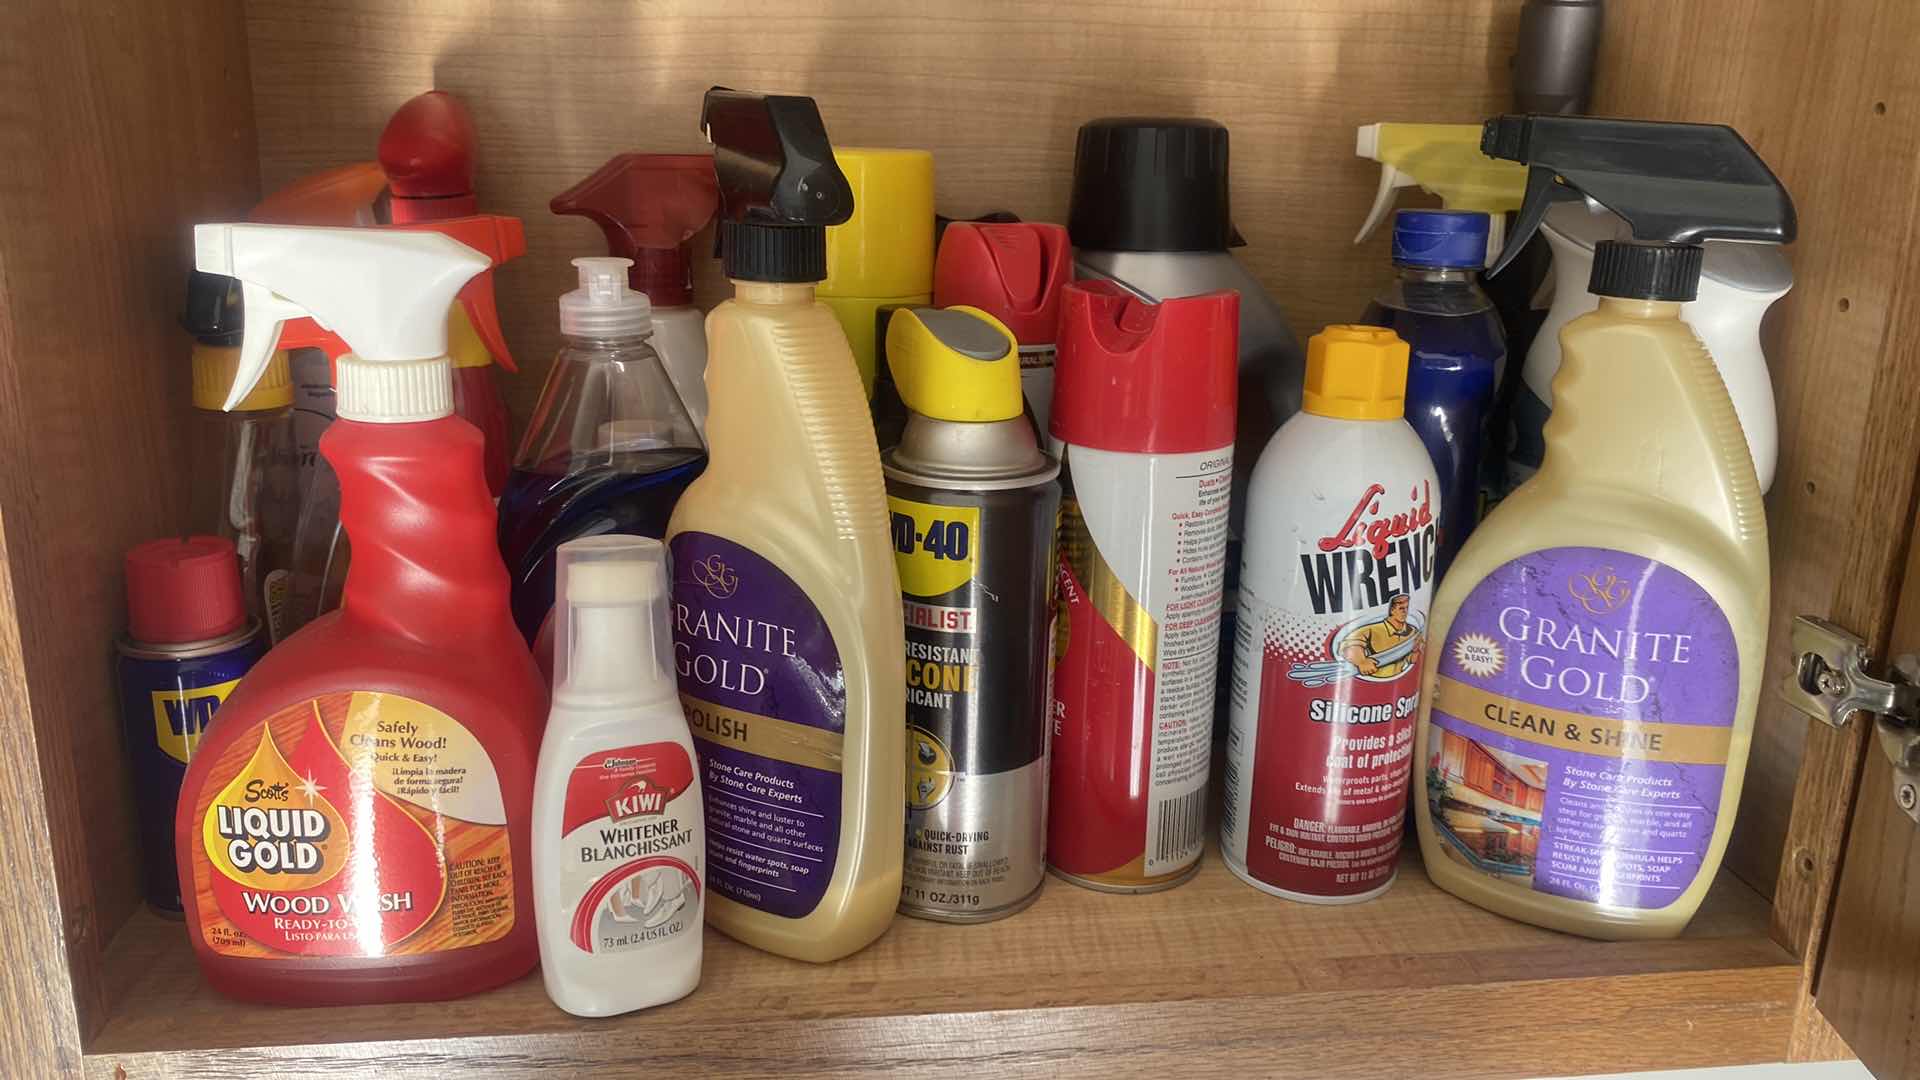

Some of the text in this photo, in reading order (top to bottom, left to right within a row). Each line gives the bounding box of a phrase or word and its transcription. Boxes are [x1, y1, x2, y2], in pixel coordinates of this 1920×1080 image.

[1318, 480, 1432, 561] Liquid
[890, 511, 969, 561] D-40
[1168, 568, 1178, 576] For
[1301, 518, 1440, 615] WRENC
[1059, 562, 1080, 604] CENT
[904, 605, 972, 630] IALIST
[674, 603, 796, 657] RANITE
[1499, 606, 1692, 664] GRANITE
[674, 642, 765, 696] GOLD
[907, 662, 977, 692] CONE
[1521, 655, 1650, 705] GOLD
[164, 695, 221, 736] WD
[1310, 695, 1420, 725] Silicone Spra
[377, 721, 418, 736] Safely
[1484, 702, 1663, 751] CLEAN & SHNE
[350, 734, 447, 749] Clans Wood!
[1334, 736, 1386, 752] Provides
[1388, 734, 1394, 747] a
[371, 752, 438, 764] Quick & Easy!
[1356, 754, 1370, 769] of
[394, 778, 404, 786] de
[436, 768, 466, 776] madera
[710, 759, 794, 789] Stone Care Products
[1565, 766, 1597, 778] Stone
[1626, 774, 1672, 787] Products
[245, 779, 289, 802] Scott's
[720, 774, 744, 789] Stone
[746, 782, 766, 795] Care
[768, 788, 802, 804] Experts
[1295, 782, 1328, 794] Extends
[1343, 787, 1352, 796] of
[1353, 786, 1374, 796] metal
[1562, 777, 1577, 788] By
[1580, 780, 1613, 792] Stone
[1640, 788, 1681, 800] Experts
[616, 794, 661, 816] KIWI
[217, 805, 328, 840] LIQUID
[733, 814, 806, 839] marble and all other
[738, 806, 805, 828] shine and luster to
[600, 819, 679, 845] WHITENER
[732, 824, 824, 852] stone and quartz surfaces
[924, 829, 990, 842] QUICK-DRYING
[228, 839, 320, 873] GOLD
[581, 829, 692, 862] BLANCHISSANT
[945, 844, 968, 855] RUST
[726, 846, 744, 858] resist
[745, 852, 766, 864] water
[767, 858, 789, 870] spots,
[790, 864, 809, 875] soap
[738, 860, 780, 878] fingerprints
[1552, 860, 1578, 871] SCUM
[1647, 865, 1672, 873] SOAP
[1657, 854, 1682, 864] HELPS
[242, 892, 329, 914] WOOD
[338, 892, 412, 913] WSH
[914, 890, 925, 900] 11
[211, 927, 222, 936] 24
[212, 936, 230, 945] (709
[285, 930, 341, 942] LISTO PARA
[603, 938, 614, 948] 73
[646, 930, 658, 940] US
